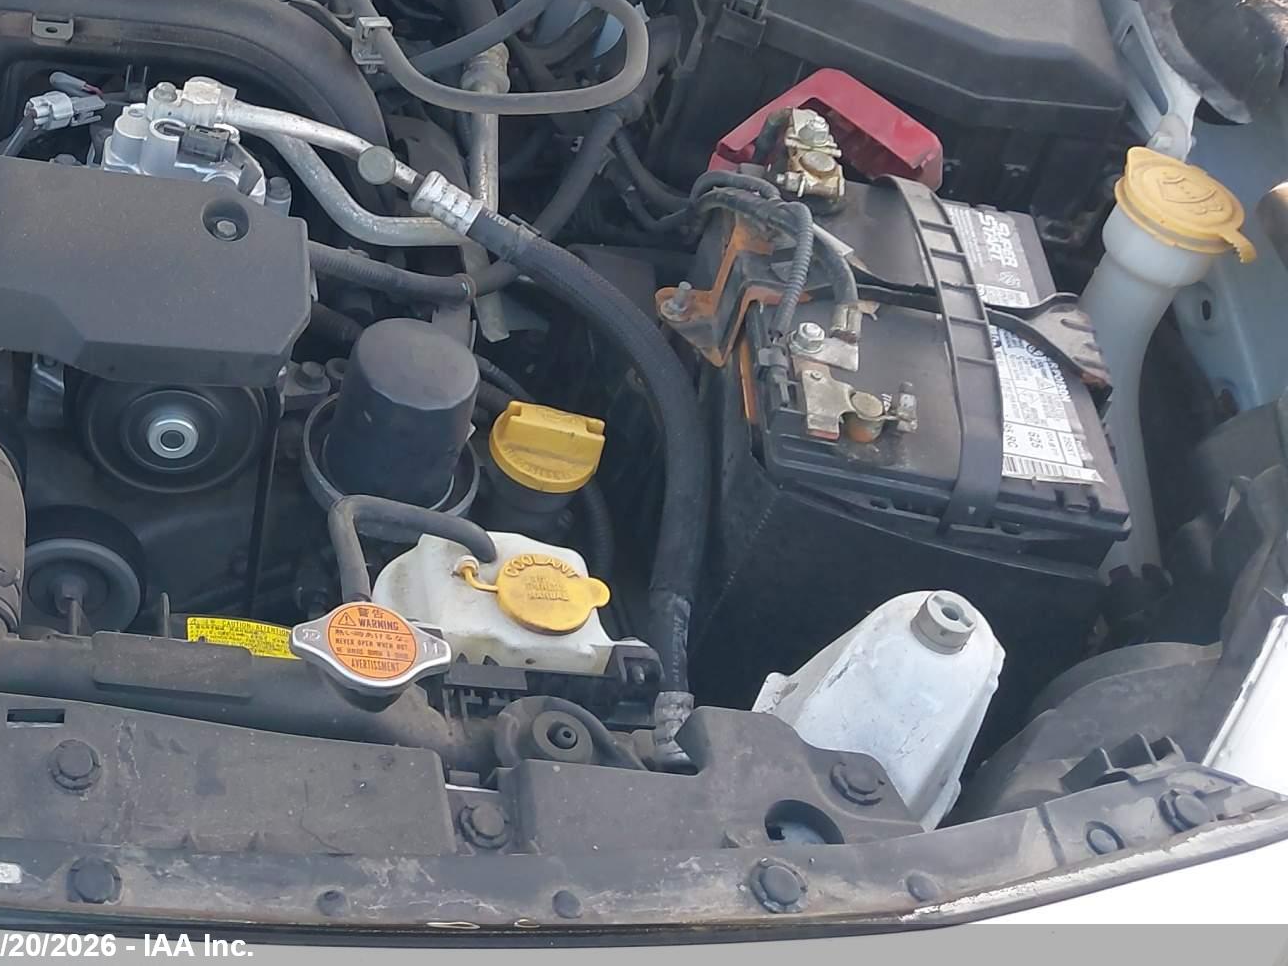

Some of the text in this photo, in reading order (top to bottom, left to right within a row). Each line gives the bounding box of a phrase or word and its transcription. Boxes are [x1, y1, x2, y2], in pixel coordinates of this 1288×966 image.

[977, 211, 1002, 263] START
[997, 221, 1018, 268] SUPER
[1050, 366, 1073, 403] POISON
[504, 553, 580, 578] COOLANT
[358, 617, 399, 631] WARNING
[335, 637, 355, 646] NEVER
[357, 639, 373, 648] OPEN
[376, 641, 393, 650] WHEN
